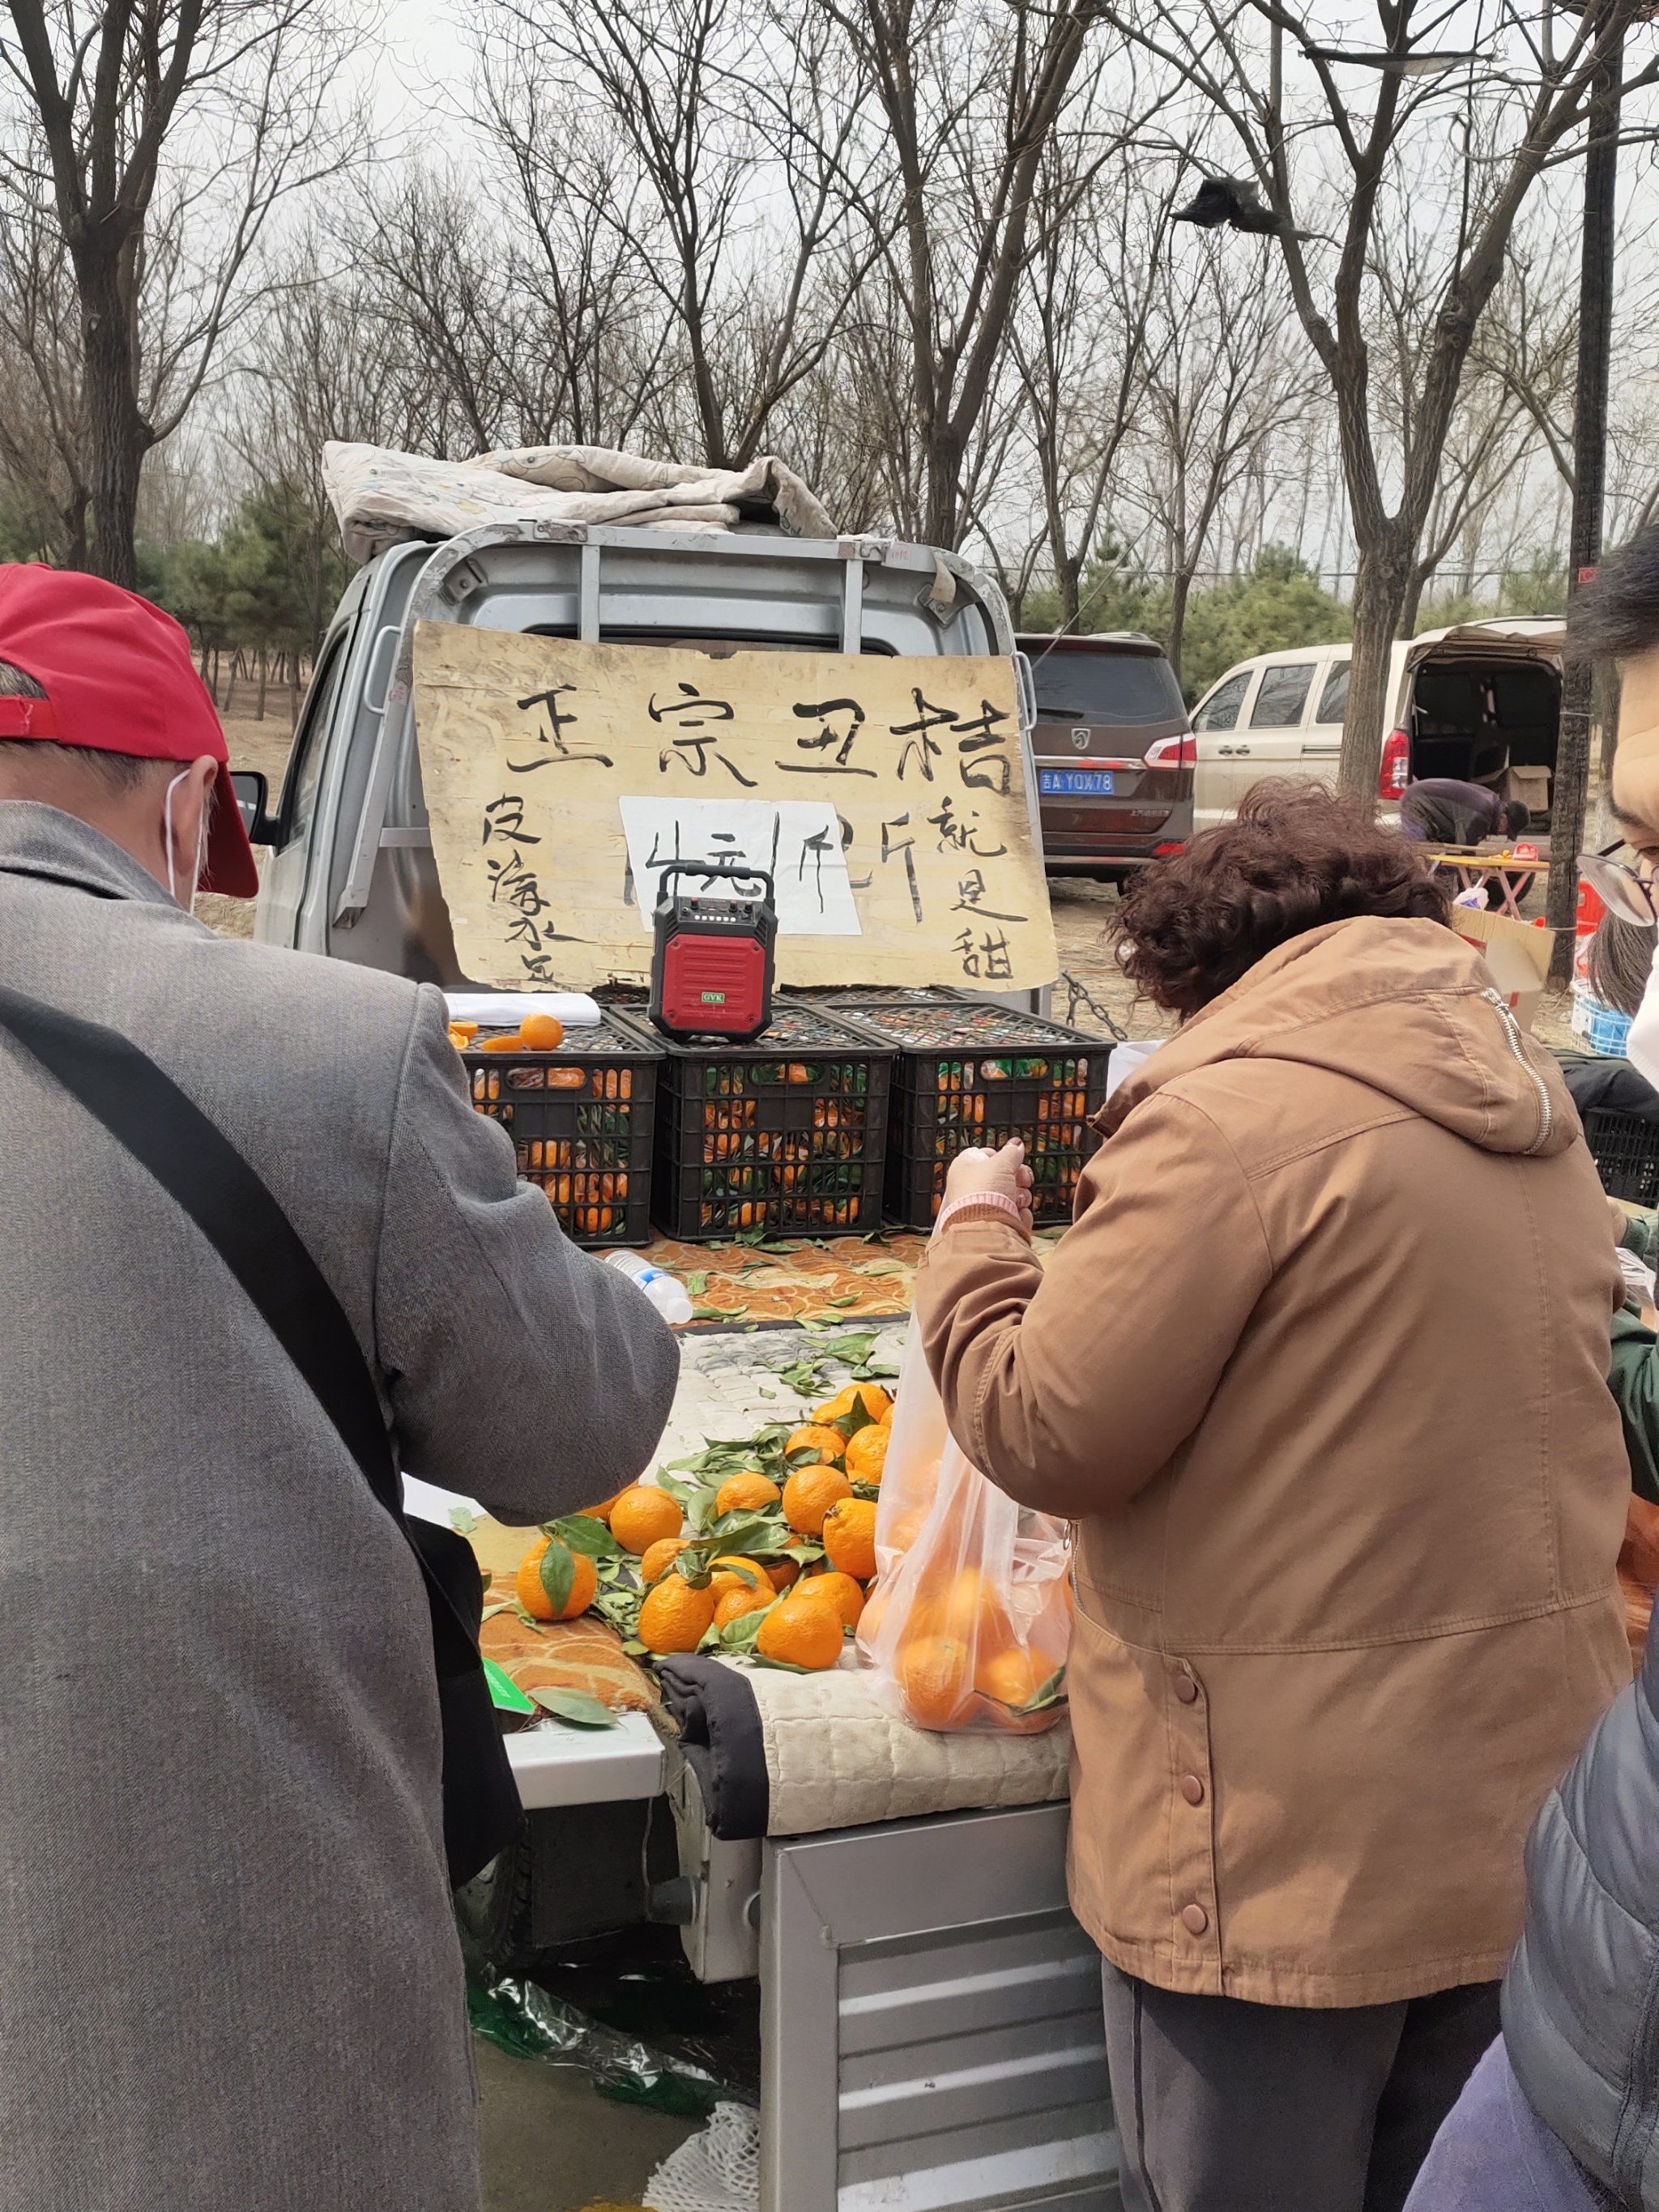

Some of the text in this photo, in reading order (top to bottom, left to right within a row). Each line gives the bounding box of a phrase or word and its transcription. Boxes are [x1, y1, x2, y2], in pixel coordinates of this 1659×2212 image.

[506, 682, 1011, 797] 正宗丑桔
[926, 795, 1029, 979] 就是甜
[703, 992, 723, 1002] GVK
